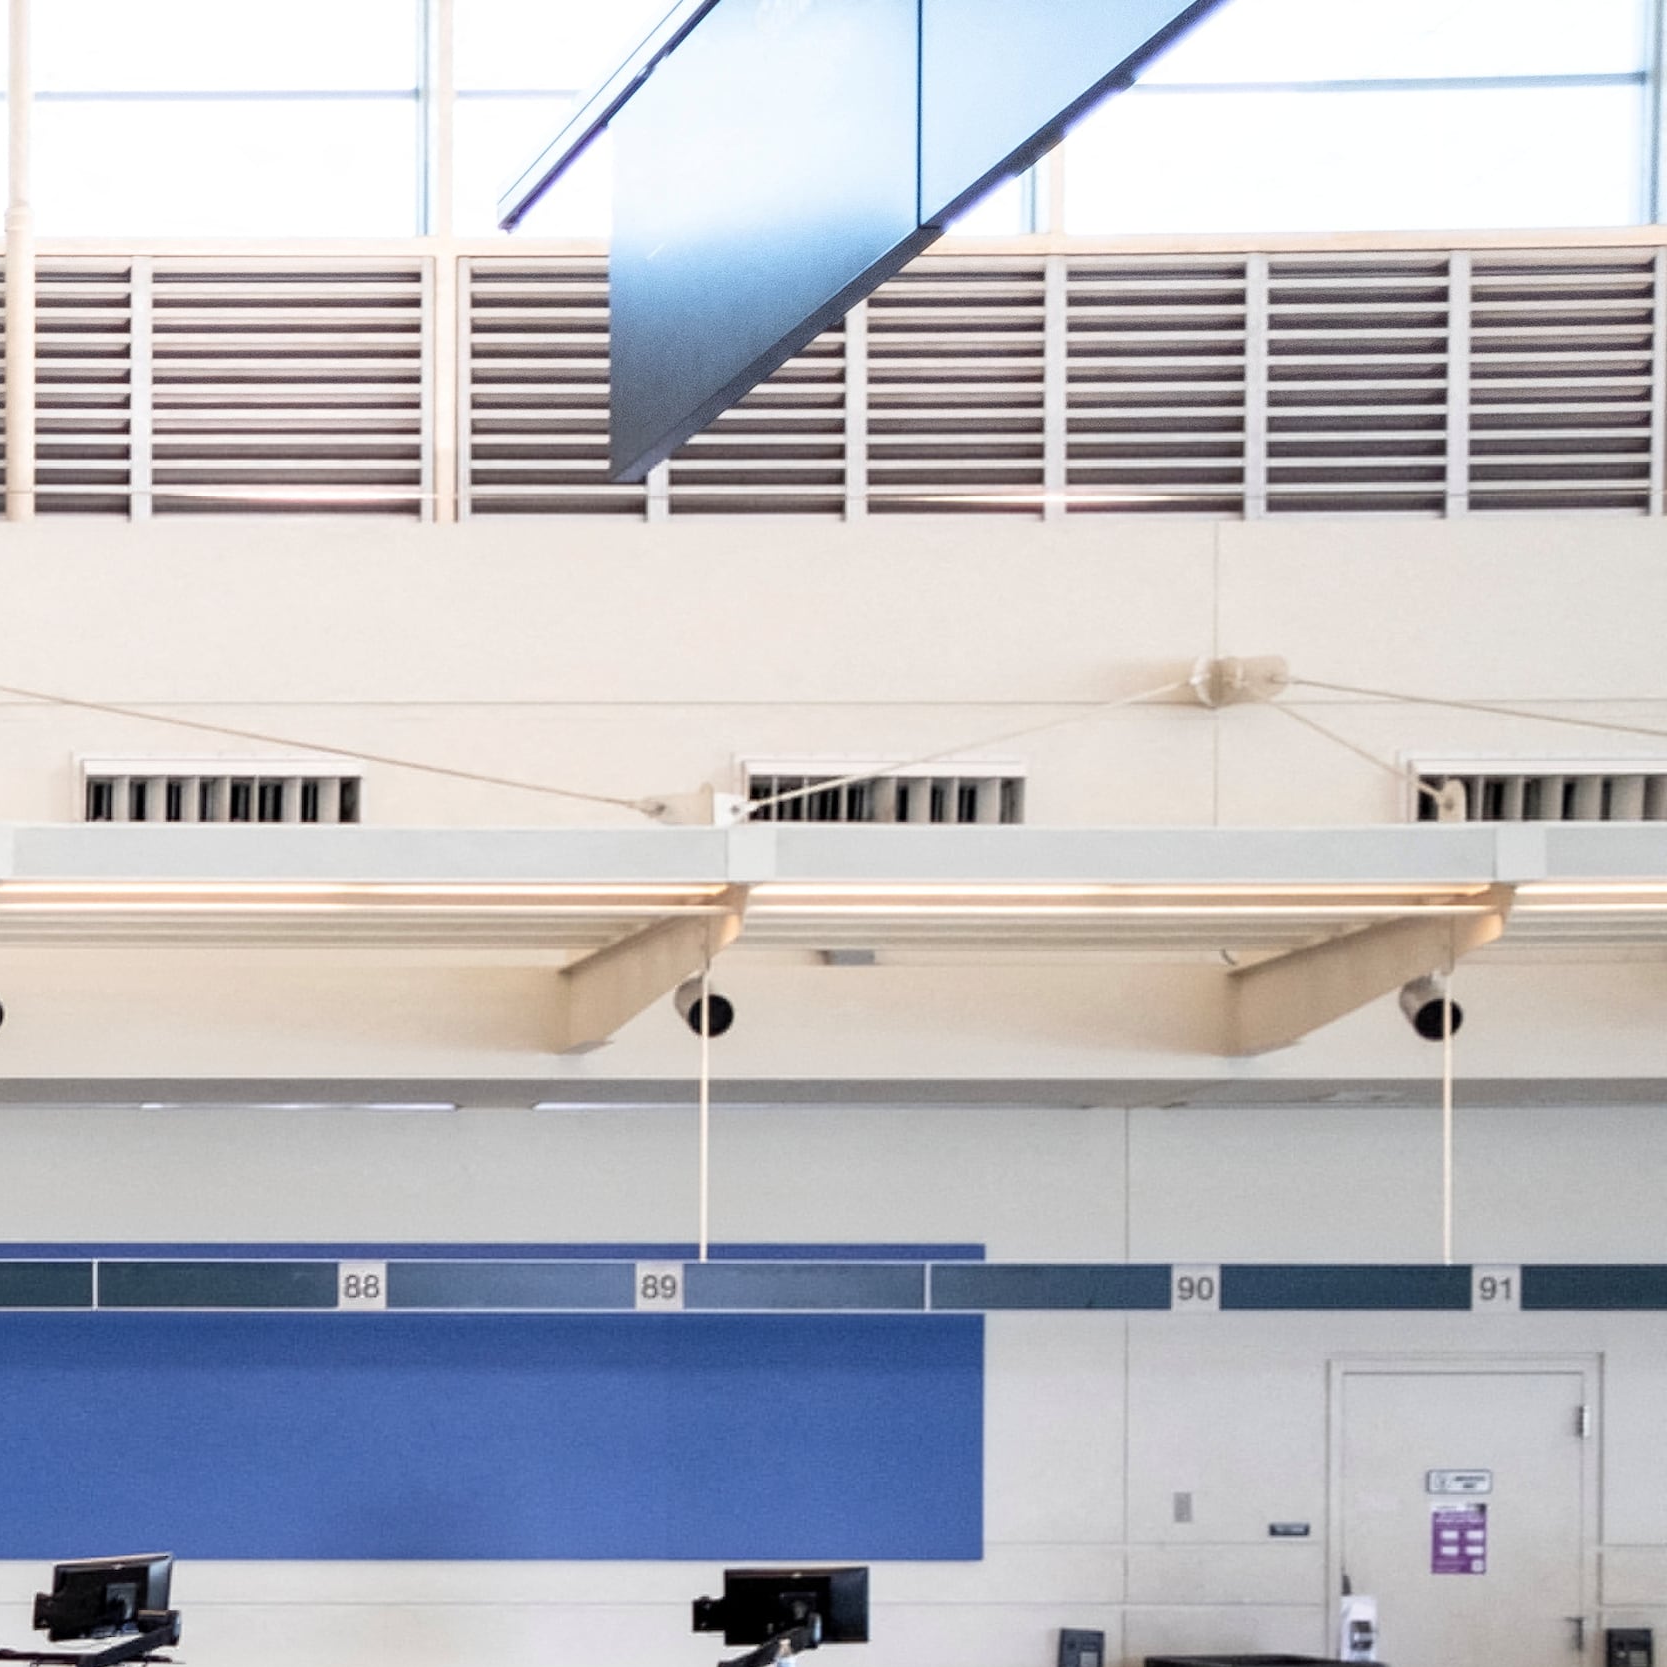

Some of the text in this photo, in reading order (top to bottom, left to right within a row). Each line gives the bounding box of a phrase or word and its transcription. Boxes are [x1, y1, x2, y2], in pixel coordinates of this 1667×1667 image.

[343, 1274, 380, 1299] 88
[641, 1275, 677, 1300] 89
[1177, 1277, 1214, 1301] 90
[1479, 1277, 1512, 1301] 91
